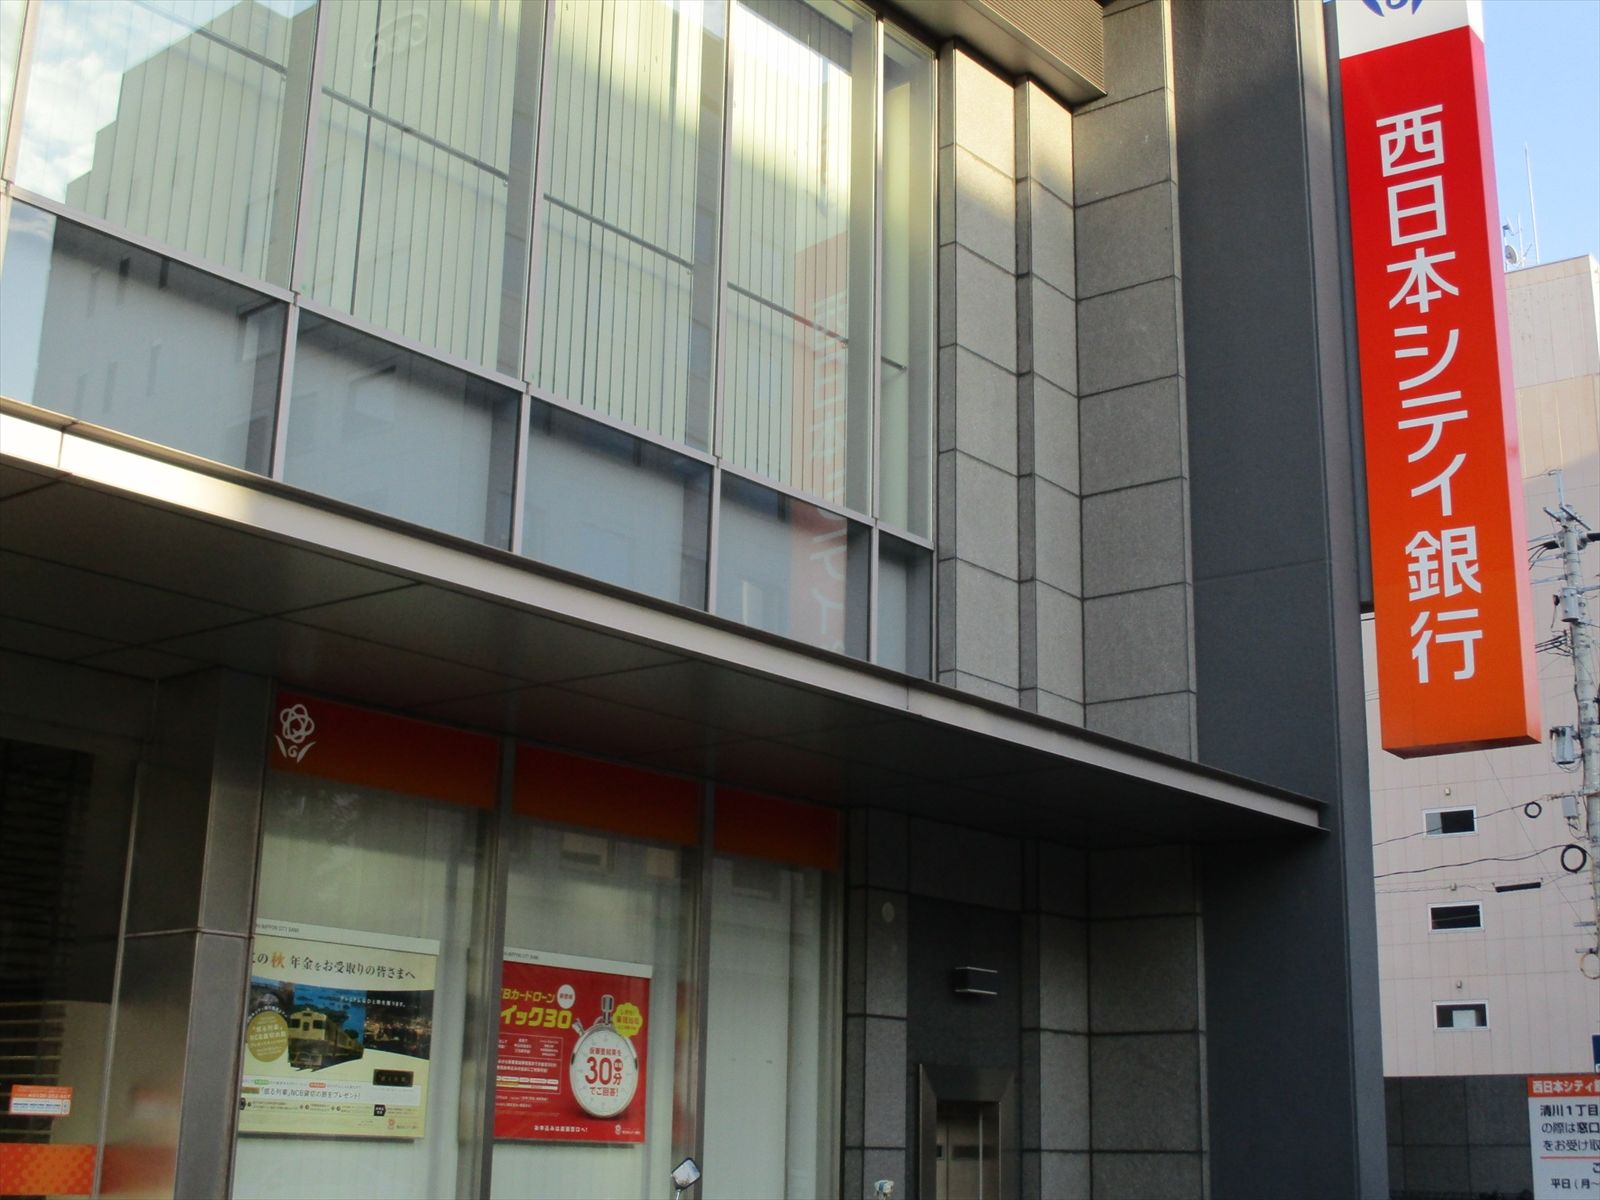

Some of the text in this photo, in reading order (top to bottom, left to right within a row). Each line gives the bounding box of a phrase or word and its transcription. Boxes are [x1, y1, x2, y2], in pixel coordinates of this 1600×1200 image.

[1376, 104, 1484, 684] 西日本シティ銀行
[500, 987, 555, 1004] Bカードローン
